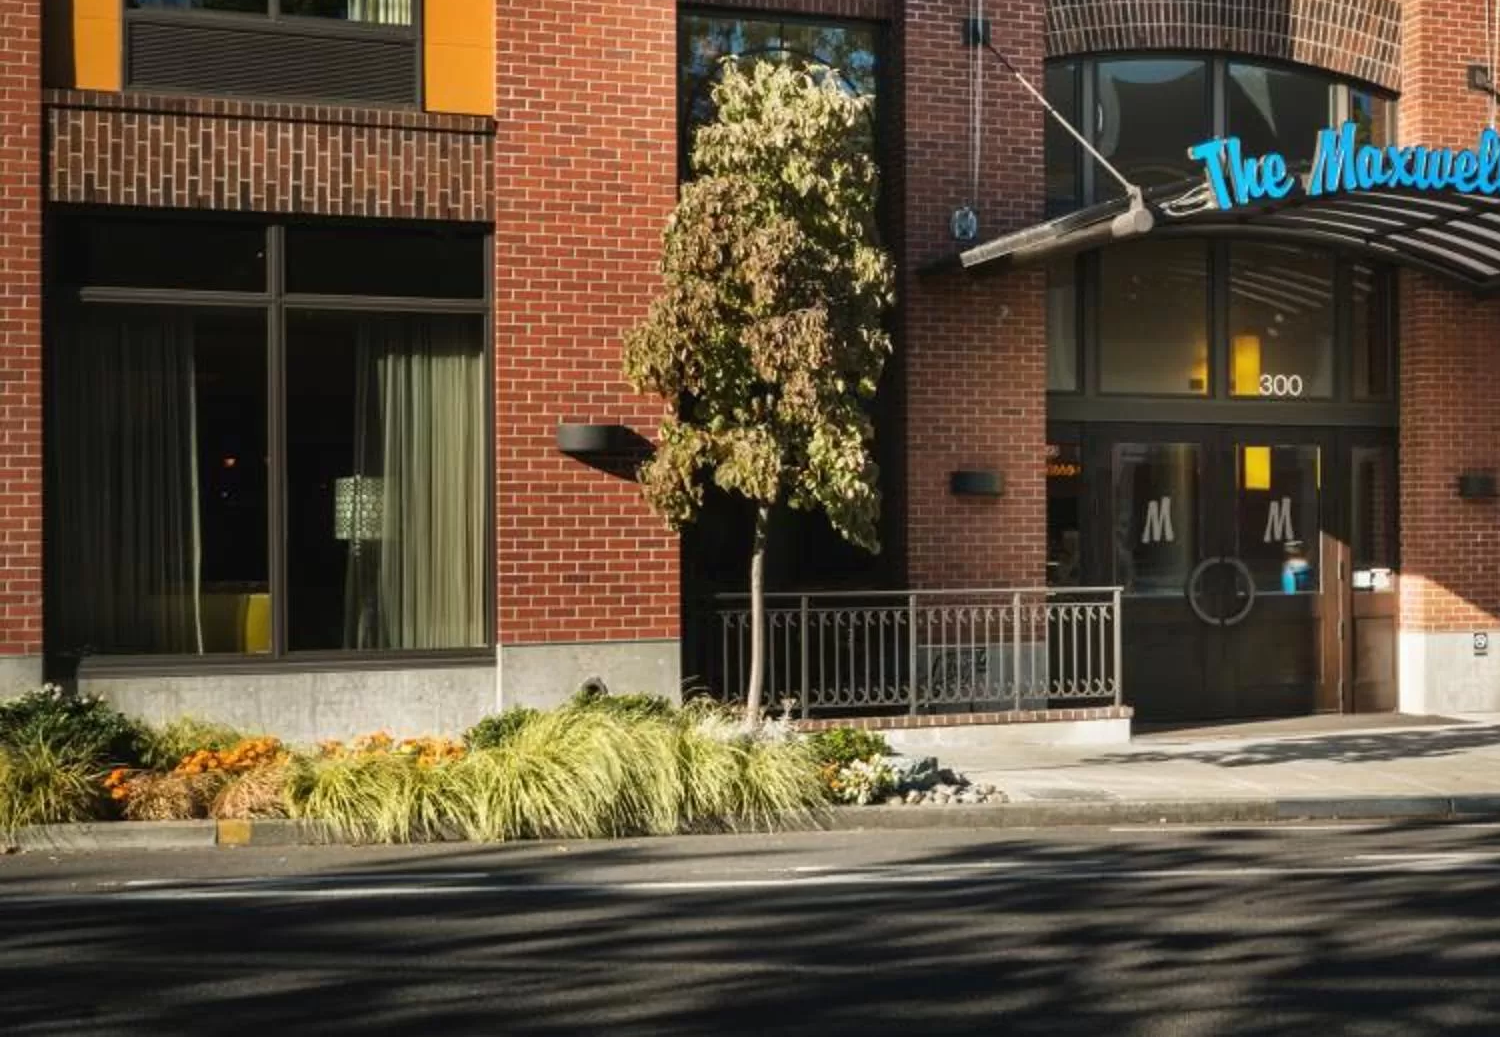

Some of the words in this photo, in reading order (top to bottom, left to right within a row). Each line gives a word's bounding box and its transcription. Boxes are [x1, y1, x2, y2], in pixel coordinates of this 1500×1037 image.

[1188, 135, 1294, 211] The
[1259, 373, 1303, 396] 300
[1142, 496, 1174, 544] M
[1263, 496, 1294, 543] M
